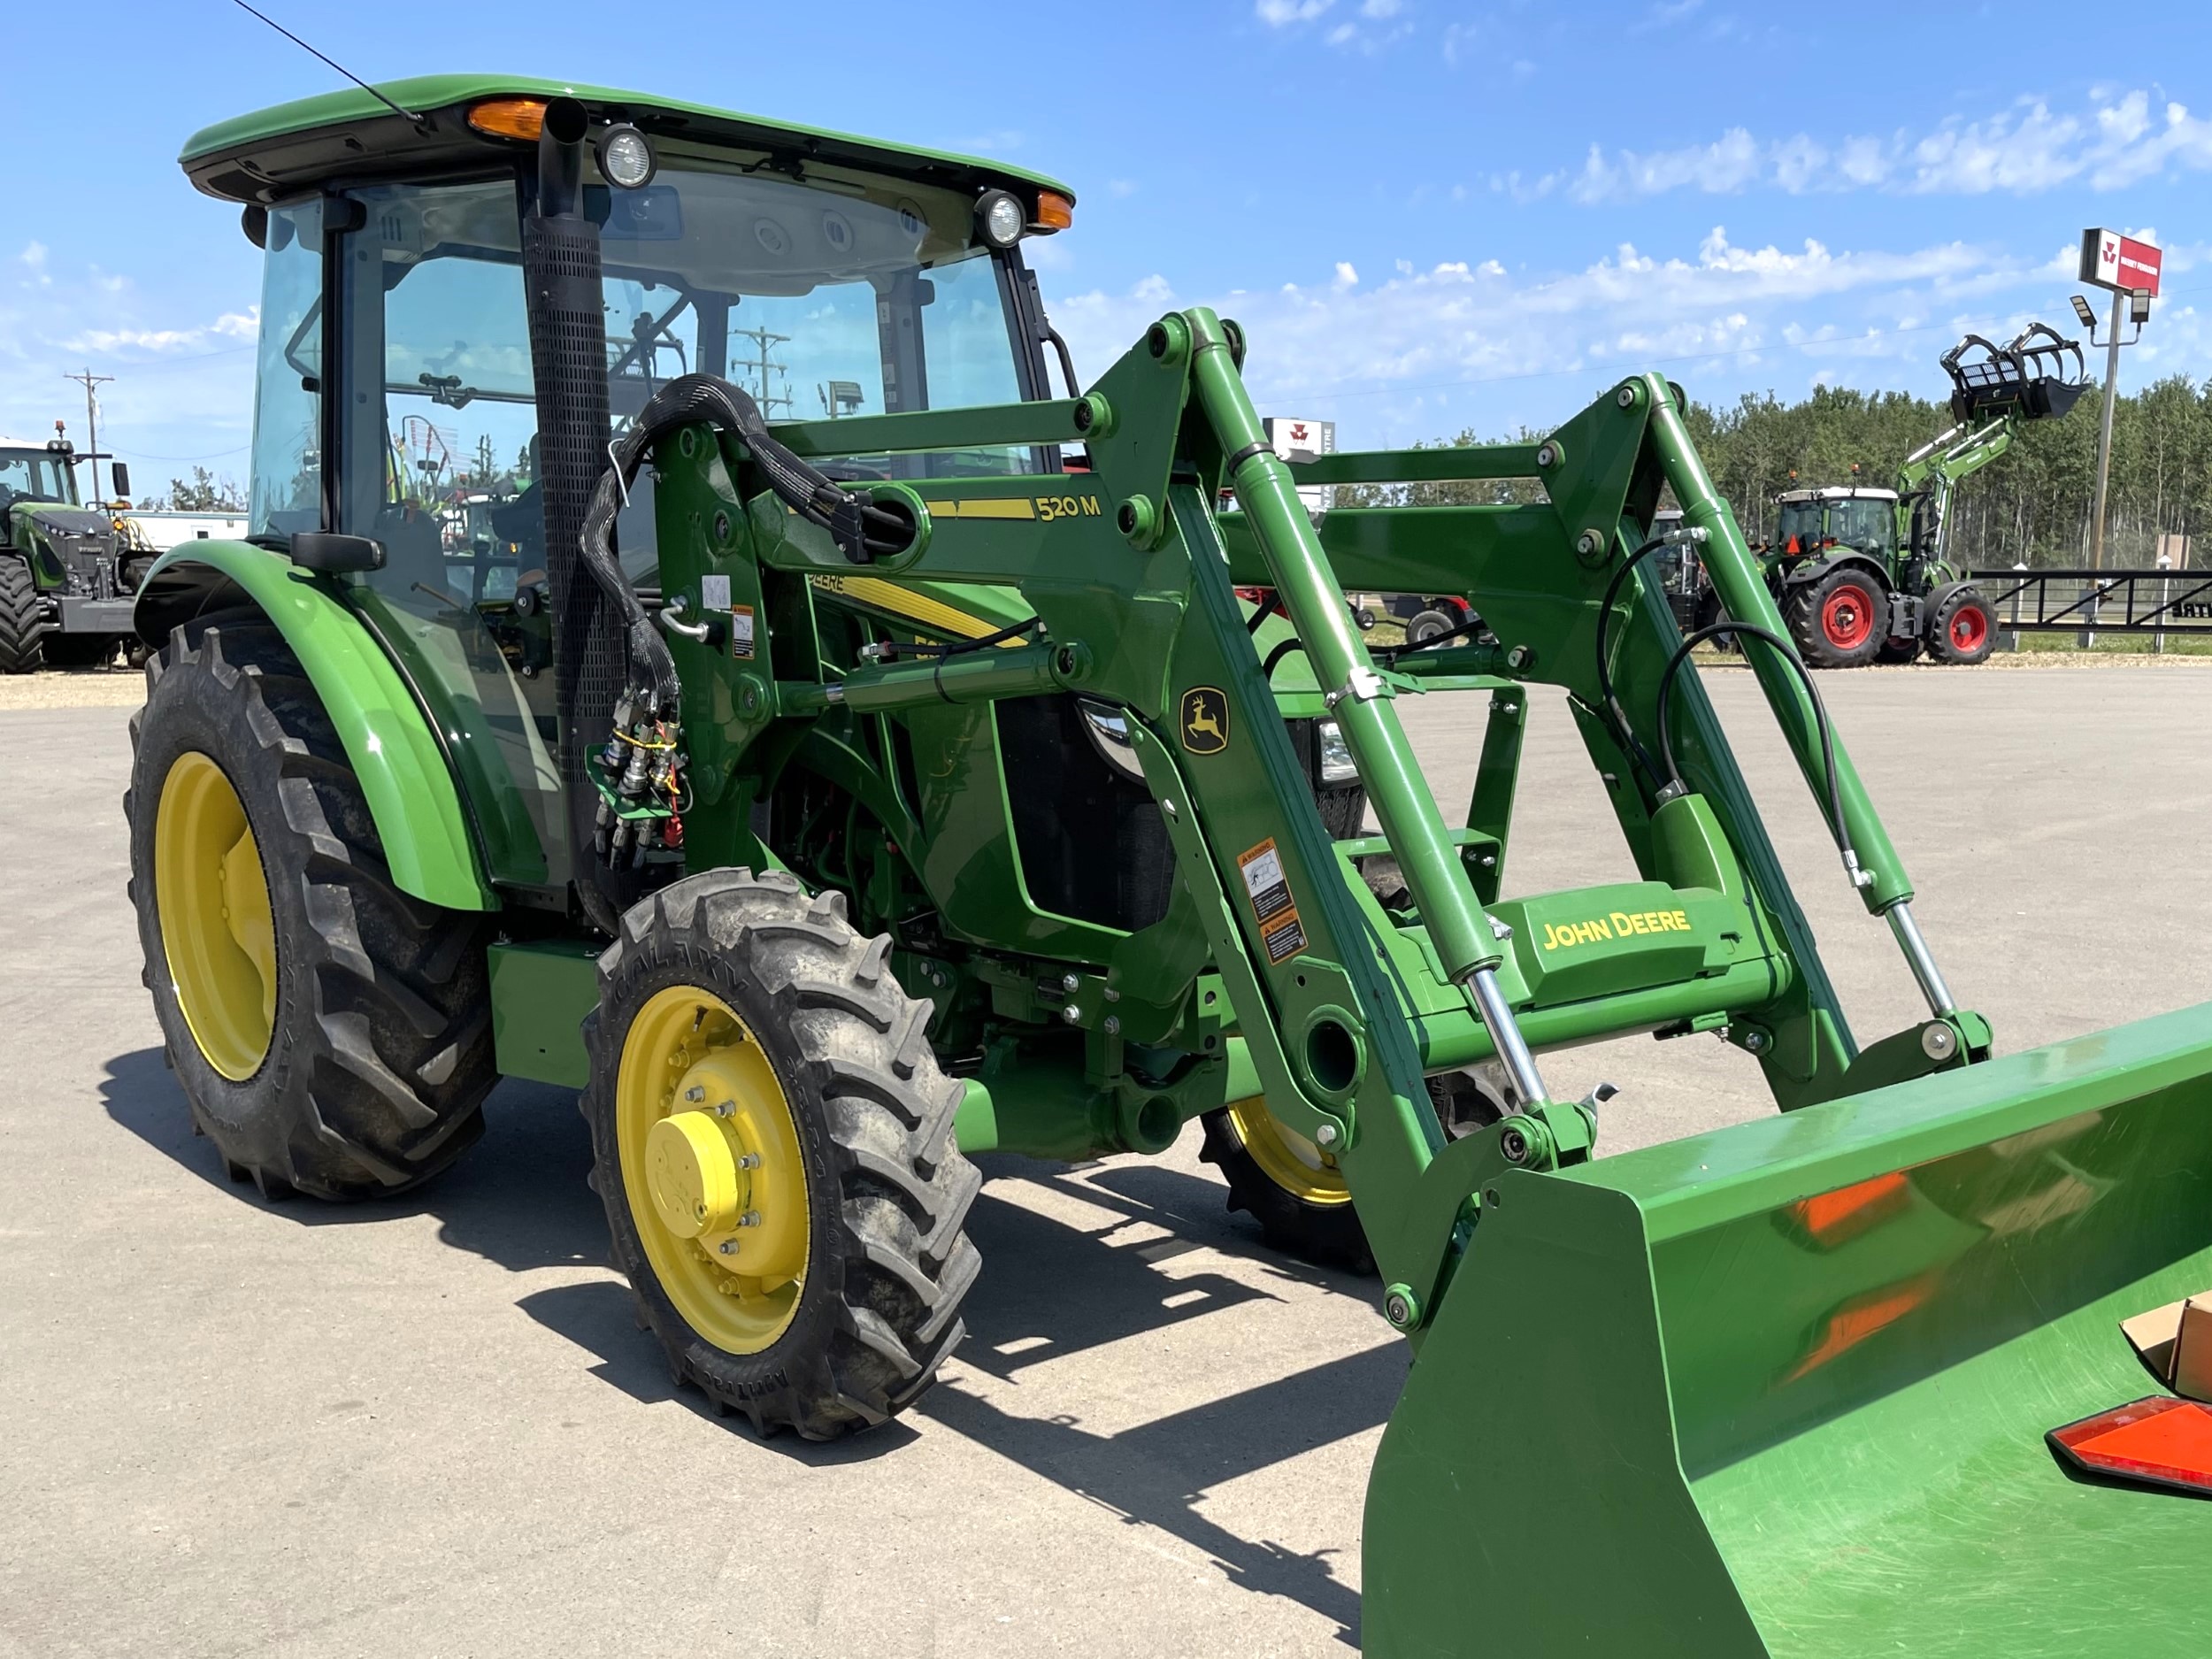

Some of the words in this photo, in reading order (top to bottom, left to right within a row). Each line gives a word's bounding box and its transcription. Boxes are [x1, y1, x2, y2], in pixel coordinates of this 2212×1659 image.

[1035, 496, 1079, 522] 520
[1079, 495, 1102, 516] M
[1543, 918, 1613, 950] JOHN
[1609, 910, 1692, 938] DEERE
